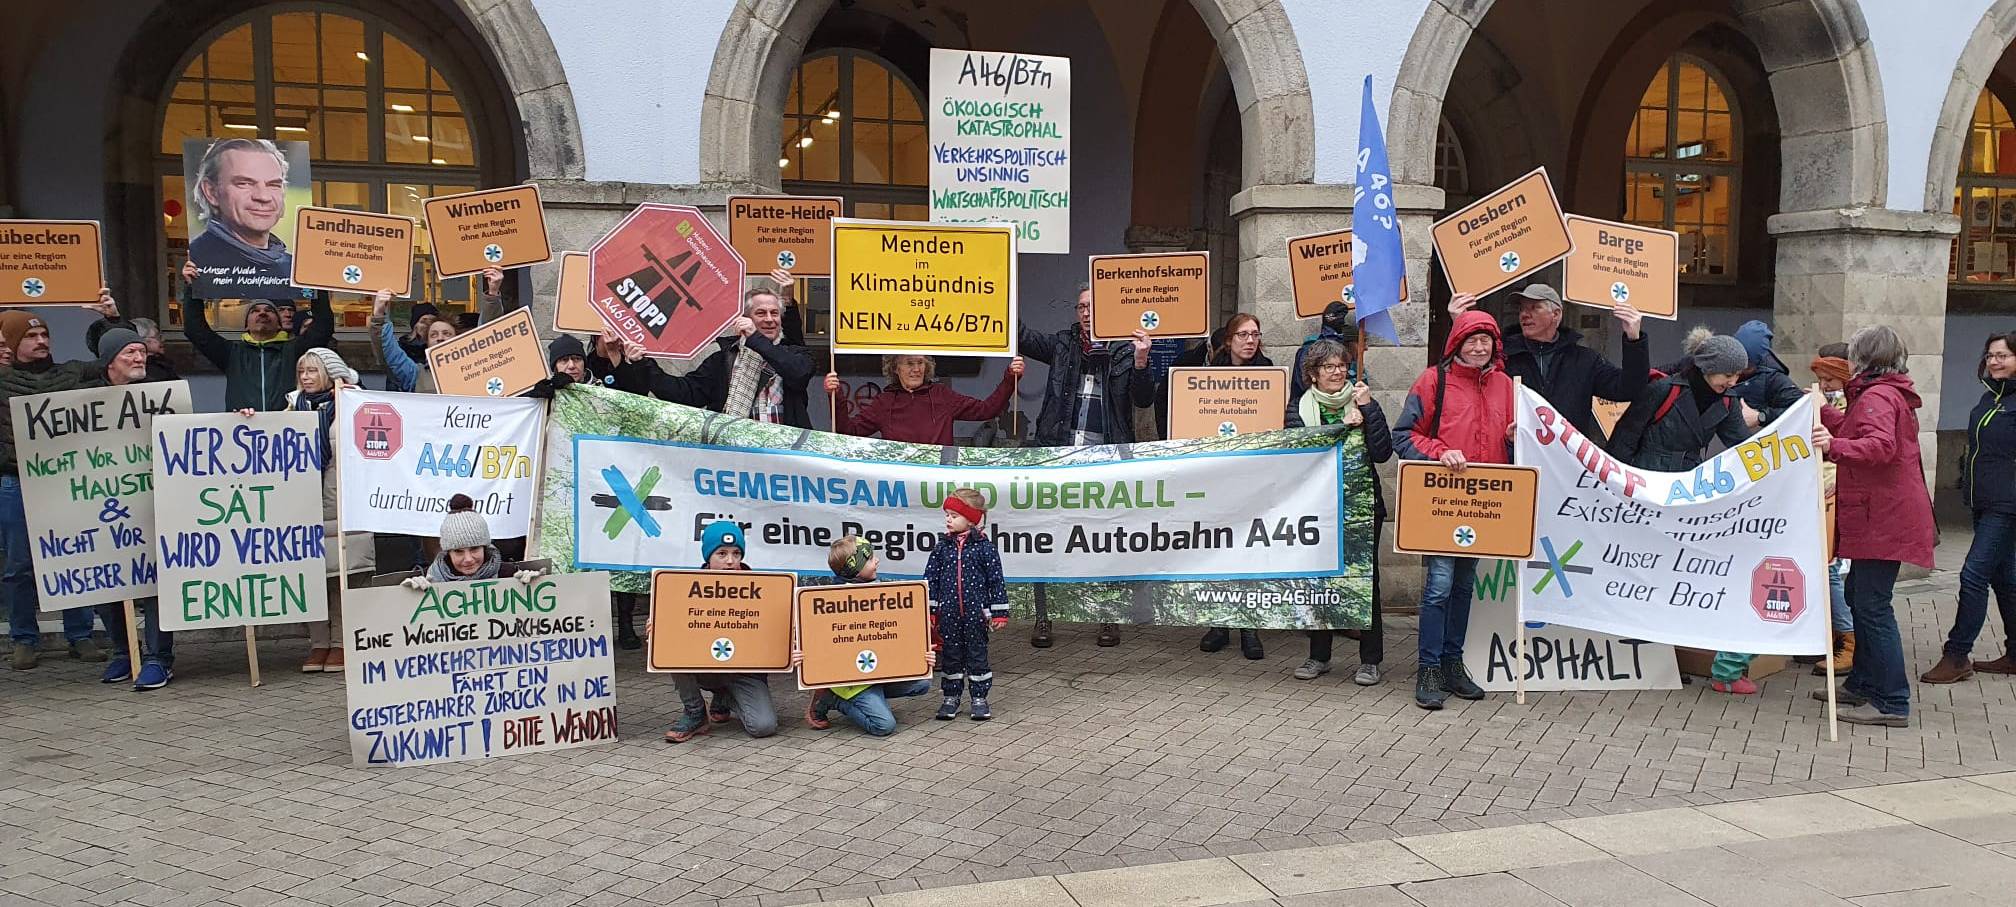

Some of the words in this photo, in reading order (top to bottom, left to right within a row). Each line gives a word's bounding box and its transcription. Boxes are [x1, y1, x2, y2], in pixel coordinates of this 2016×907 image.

[958, 53, 1052, 96] A46/B7n
[943, 96, 1044, 119] ÖKOLOGISCH
[957, 119, 1063, 139] KATASTROPHAL
[933, 142, 1068, 166] VERKEHRSPOLITISCH
[957, 166, 1030, 183] UNSINNIG
[445, 198, 521, 219] Wimbern
[932, 186, 1069, 210] WIRTSCHAFTSPOLITISCH
[735, 203, 835, 220] Platte-Heide
[1457, 193, 1527, 236] Oesbern
[0, 229, 81, 245] übecken
[306, 215, 405, 240] Landhausen
[881, 234, 964, 255] Menden
[1598, 230, 1644, 255] Barge
[232, 266, 256, 275] Wald
[915, 259, 929, 270] im
[1096, 265, 1203, 280] Berkenhofskamp
[213, 277, 233, 285] mein
[851, 272, 995, 295] Klimabündnis
[616, 278, 668, 328] STOPP
[910, 297, 935, 309] sagt
[601, 296, 646, 343] A46/B7n
[840, 312, 892, 331] NEIN
[897, 322, 910, 331] zu
[914, 312, 1004, 334] A46/B7n
[435, 320, 529, 368] Fröndenberg
[1187, 376, 1270, 391] Schwitten
[25, 398, 109, 440] KEINE
[443, 405, 492, 429] Keine
[26, 450, 78, 478] NICHT
[86, 446, 118, 470] VOR
[159, 427, 228, 476] WER
[415, 442, 531, 480] A46/B7n
[1664, 455, 1735, 506] A46
[1735, 430, 1811, 483] B7n
[693, 467, 909, 508] GEMEINSAM
[1009, 475, 1175, 510] ÜBERALL
[1424, 472, 1513, 496] Böingsen
[99, 497, 131, 523] &
[197, 483, 274, 525] SÄT
[369, 487, 412, 511] durch
[416, 495, 484, 514] unsen
[486, 492, 515, 515] Ort
[1432, 496, 1447, 505] Für
[1450, 498, 1469, 506] eine
[1470, 498, 1502, 510] Region
[1432, 508, 1454, 517] ohne
[1456, 509, 1501, 520] Autobahn
[39, 527, 99, 560] NICHT
[110, 522, 146, 550] VOR
[160, 531, 221, 568] WIRD
[231, 524, 326, 565] VERKEHR
[763, 517, 832, 547] eine
[991, 523, 1054, 554] hne
[1064, 521, 1234, 554] Autobahn
[1246, 515, 1320, 548] A46
[1602, 543, 1663, 569] Unser
[1672, 548, 1734, 577] Land
[43, 562, 126, 597] UNSERER
[688, 580, 762, 600] Asbeck
[182, 573, 307, 621] ERNTEN
[410, 581, 557, 624] ACHTUNG
[813, 591, 914, 615] Rauherfeld
[1196, 588, 1340, 609] www.giga46.info
[1605, 580, 1659, 602] euer
[1669, 581, 1727, 611] Brot
[1766, 599, 1790, 611] STOPP
[688, 607, 705, 617] Für
[706, 607, 727, 617] eine
[728, 607, 760, 620] Region
[688, 620, 711, 629] ohne
[714, 620, 759, 630] Autobahn
[831, 622, 846, 632] Für
[848, 620, 867, 631] eine
[868, 618, 898, 630] Region
[354, 628, 394, 651] EINE
[403, 622, 479, 647] WICHTIGE
[832, 634, 855, 644] ohne
[856, 631, 898, 643] Autobahn
[362, 659, 386, 685] IM
[395, 635, 608, 680] VERKEHRTMINISTERIUM
[452, 670, 508, 695] FÄHRT
[517, 666, 548, 689] EIN
[351, 694, 476, 731] GEISTERFAHRER
[484, 687, 546, 716] ZURÜCK
[558, 682, 577, 704] IN
[584, 675, 611, 700] DIE
[365, 721, 474, 764] ZUKUNFT
[503, 715, 545, 750] BITTE
[551, 705, 618, 744] WENDEN
